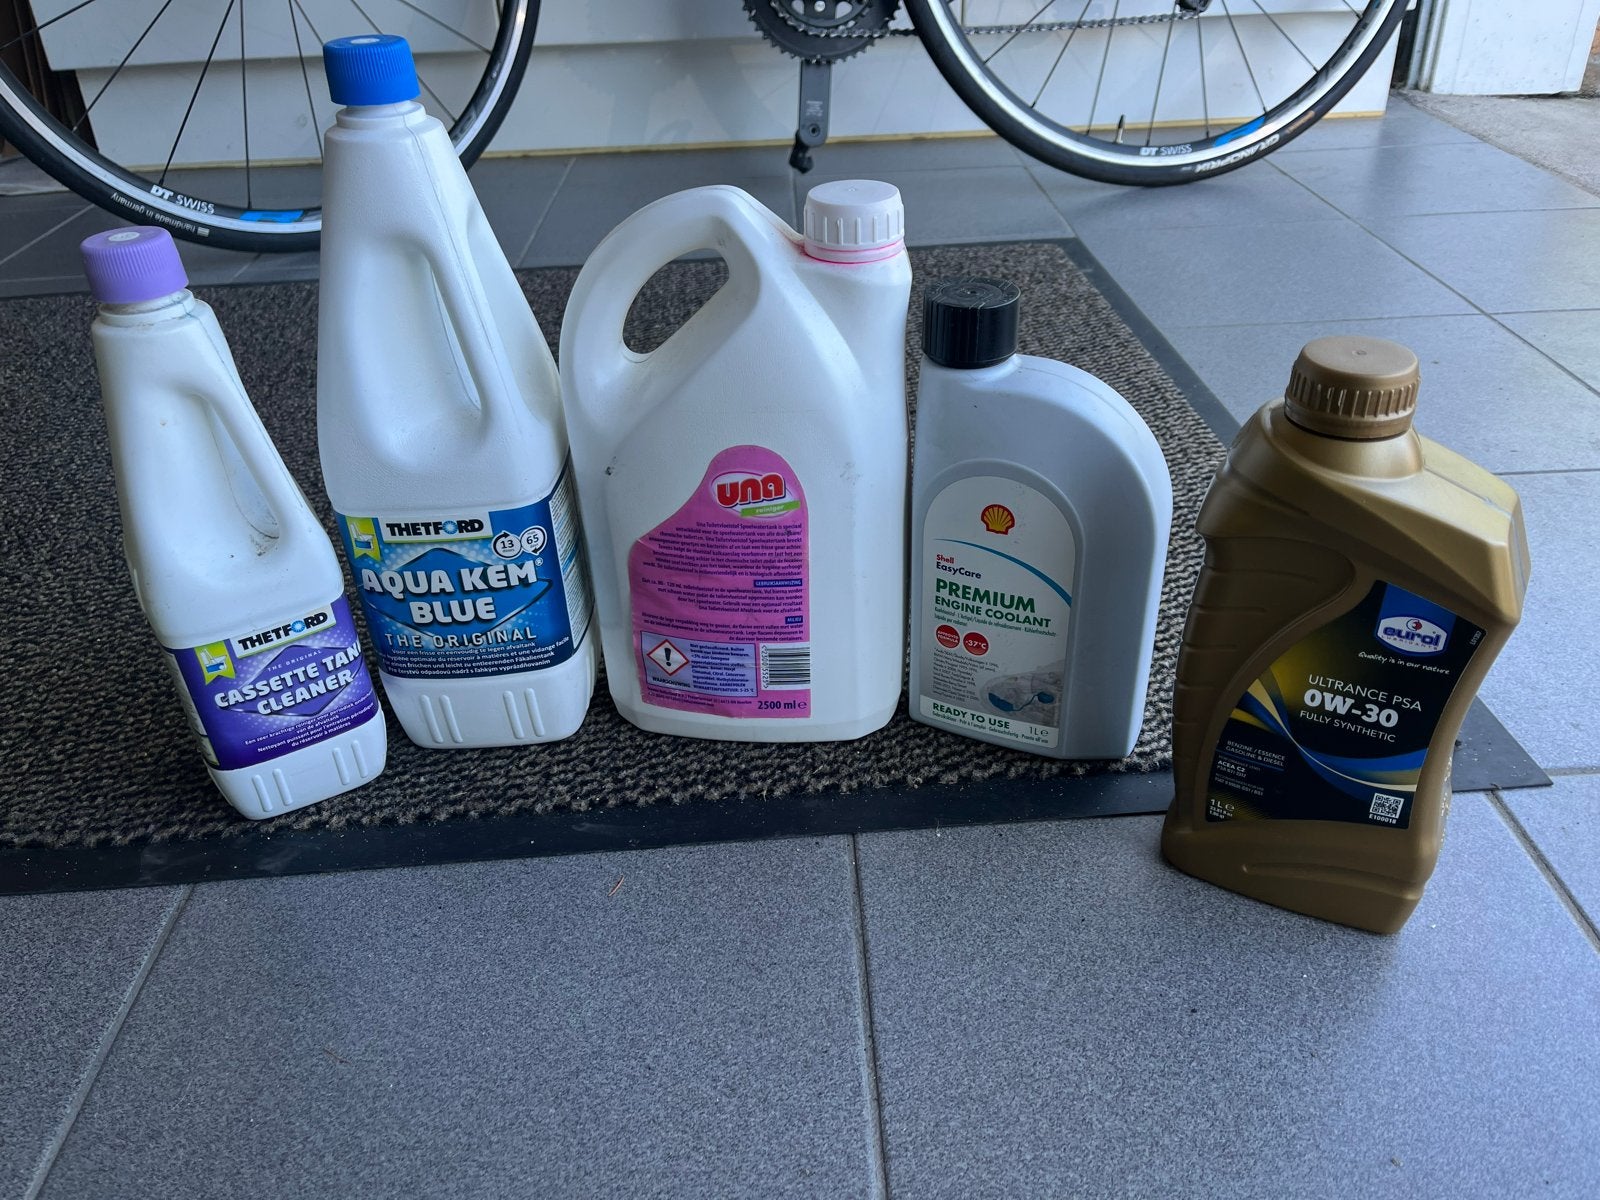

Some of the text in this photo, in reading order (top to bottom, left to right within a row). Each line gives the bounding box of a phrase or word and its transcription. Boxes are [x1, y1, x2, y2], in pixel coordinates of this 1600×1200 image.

[1140, 144, 1192, 156] DT SWISS
[150, 184, 215, 215] DT SWISS
[110, 192, 196, 234] handmade in germany
[717, 474, 785, 507] una
[386, 519, 484, 537] THETFORD
[500, 534, 539, 549] 13 65
[936, 554, 955, 564] Shell
[936, 561, 982, 579] EasyCare
[362, 568, 455, 600] AQUA
[936, 578, 1035, 613] PREMIUM
[409, 597, 496, 624] BLUE
[935, 595, 982, 616] ENGINE
[985, 609, 1051, 628] COOLANT
[238, 612, 328, 650] THETFORD
[385, 626, 537, 648] THE ORIGINAL
[1383, 626, 1442, 647] eurol
[481, 652, 509, 660] matières
[531, 645, 556, 654] vidange
[555, 636, 569, 647] facile
[506, 642, 536, 650] afvaltank
[268, 649, 322, 672] THE ORIGINAL
[472, 658, 515, 667] entleerenden
[1358, 651, 1387, 664] Quality
[1388, 656, 1395, 664] is
[1397, 658, 1405, 666] in
[1422, 664, 1450, 675] nature
[214, 641, 362, 708] CASSETTE TAN
[257, 669, 354, 716] CLEANER
[1308, 674, 1422, 712] ULTRANCE PSA
[757, 700, 796, 710] 2500 ml
[932, 702, 1010, 729] READY TO USE
[1303, 688, 1399, 728] 0W-30
[270, 726, 295, 739] krachtige
[315, 715, 339, 728] afvaltank
[328, 721, 351, 733] matières
[1300, 710, 1397, 743] FULLY SYNTHETIC
[257, 740, 287, 753] Nettoyant
[286, 732, 310, 744] puissant
[310, 728, 323, 736] pour
[1227, 740, 1253, 752] BENZINE
[1257, 749, 1286, 761] ESSENCE
[1217, 760, 1236, 770] ACEA
[1225, 745, 1257, 759] GASOLINE
[1263, 757, 1284, 767] DIESEL
